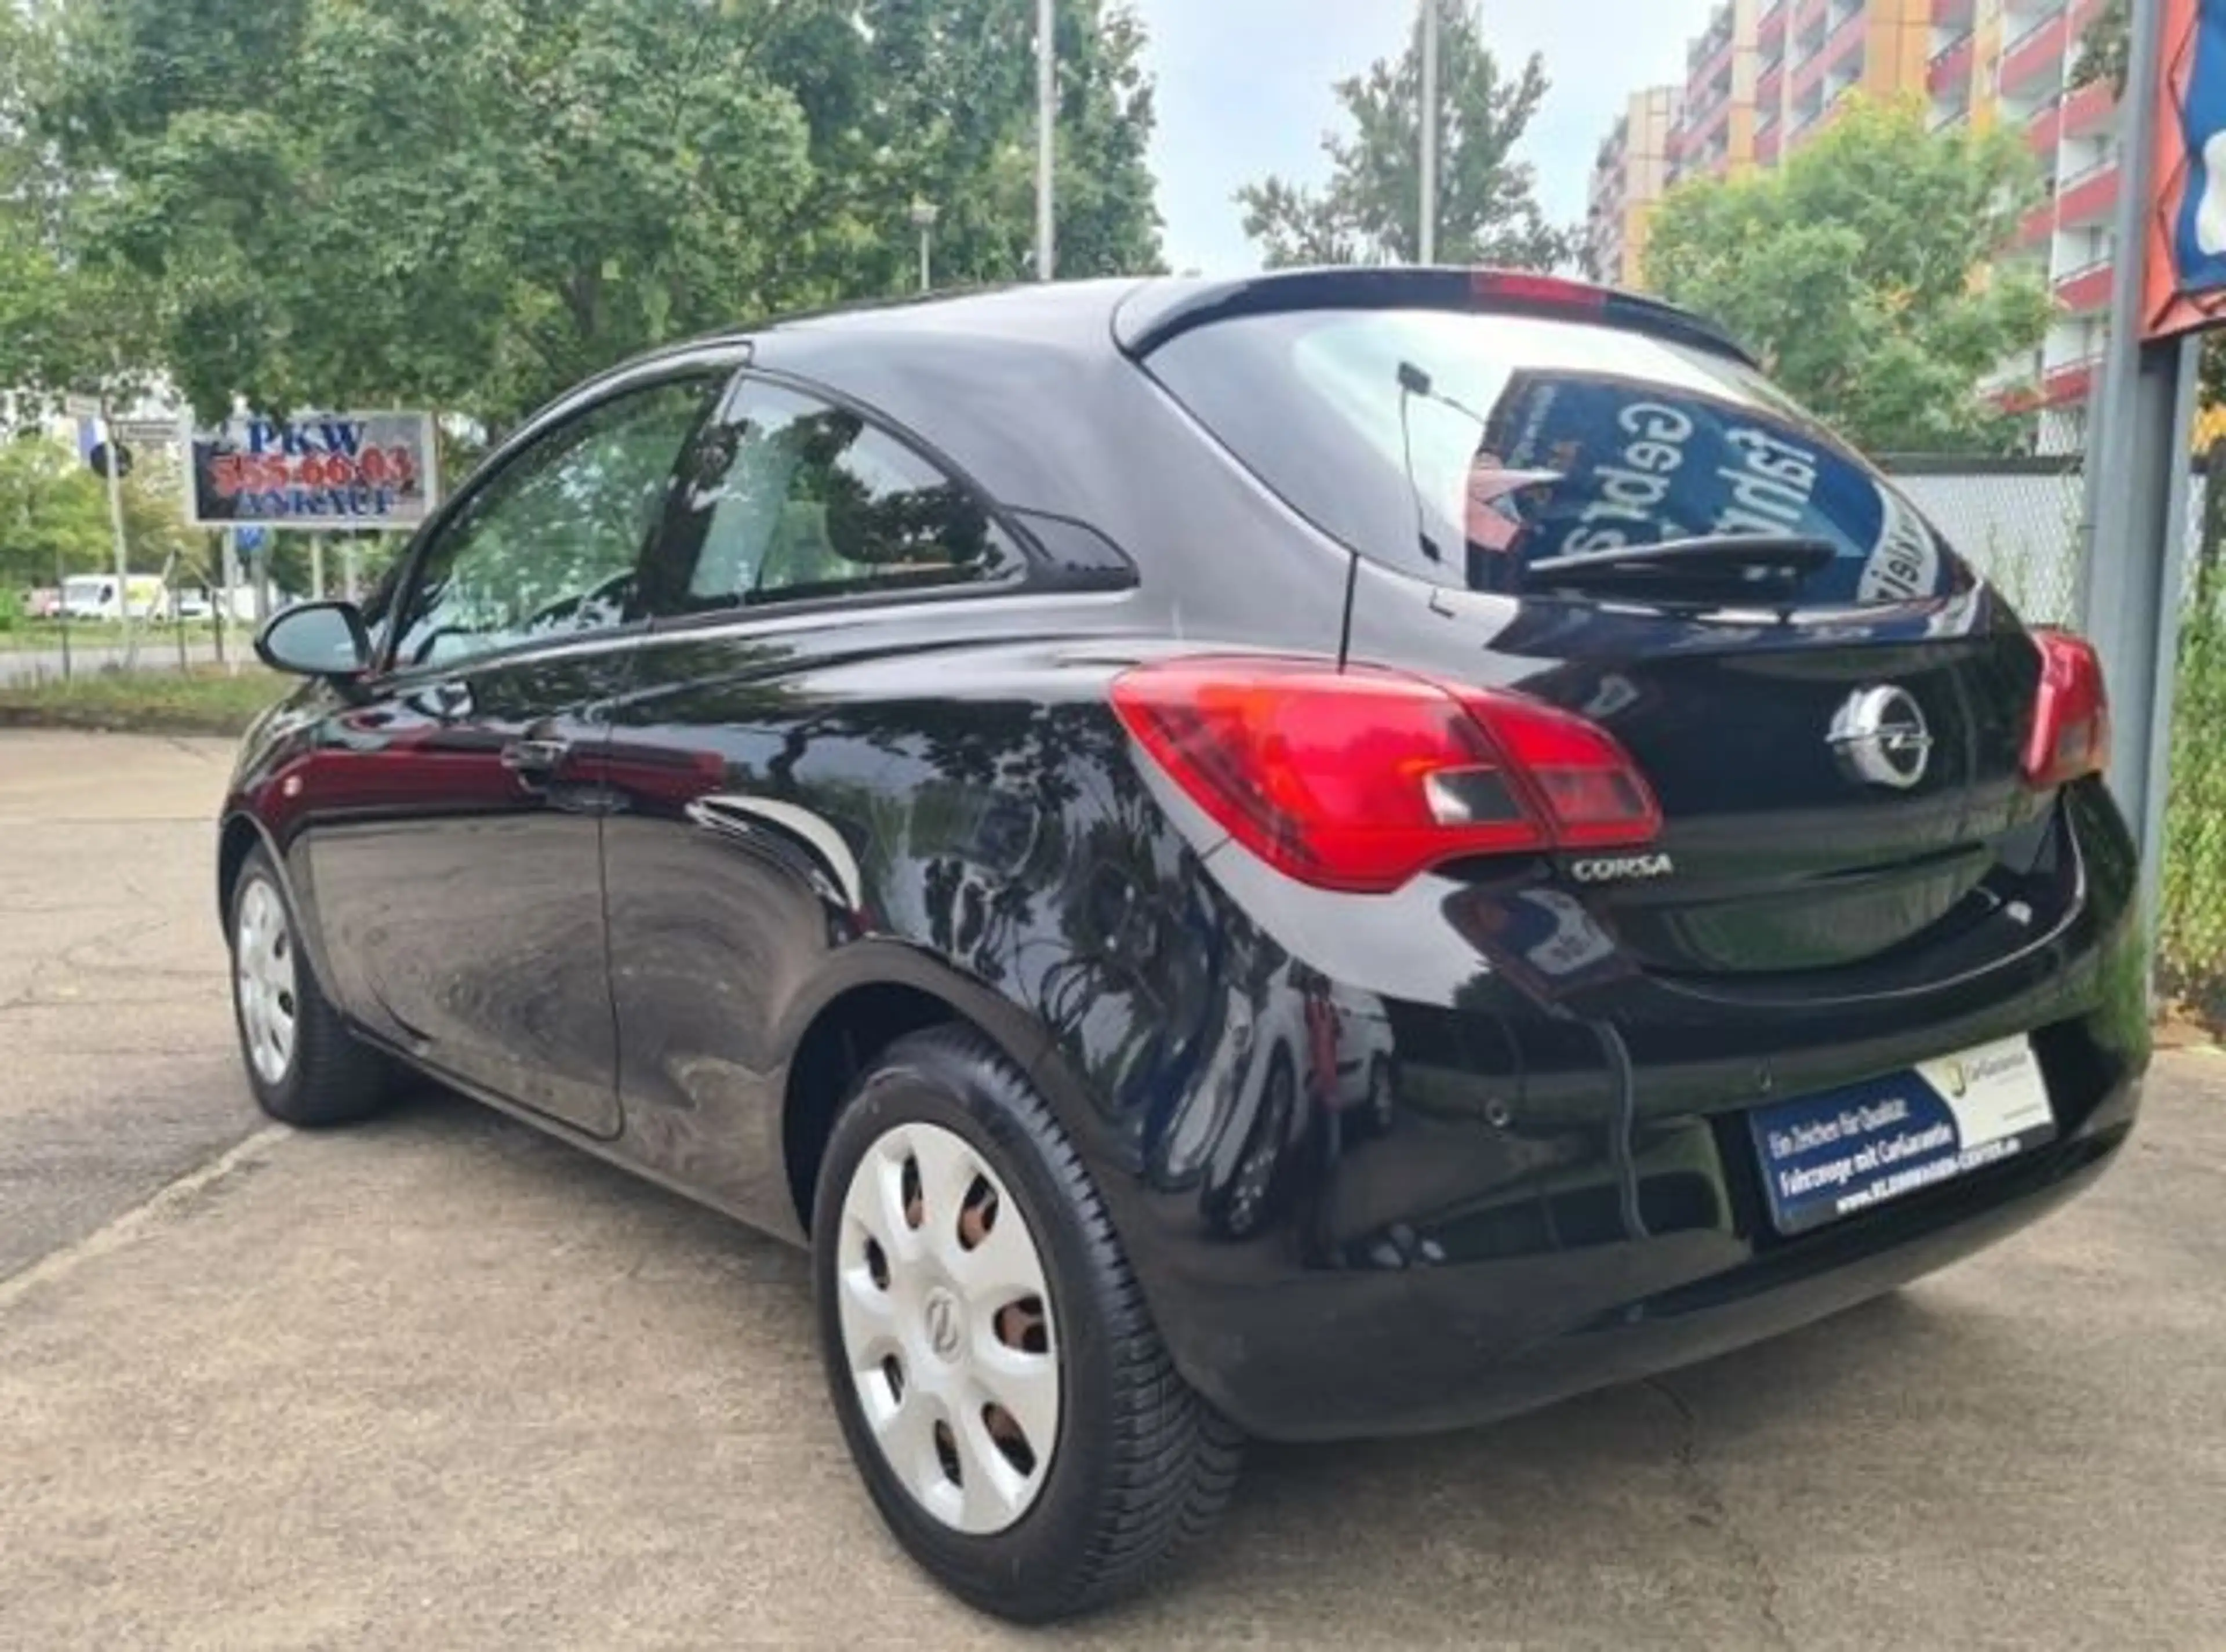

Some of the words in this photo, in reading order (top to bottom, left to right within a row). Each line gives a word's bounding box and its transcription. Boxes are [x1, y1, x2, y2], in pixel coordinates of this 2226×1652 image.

[248, 420, 366, 454] PKW
[239, 487, 395, 515] ANKAUF
[1572, 853, 1674, 882] CORSA
[1768, 1131, 1792, 1159] Ein
[1780, 1159, 1853, 1198] Fahrzeuge
[1853, 1143, 1879, 1173] mit
